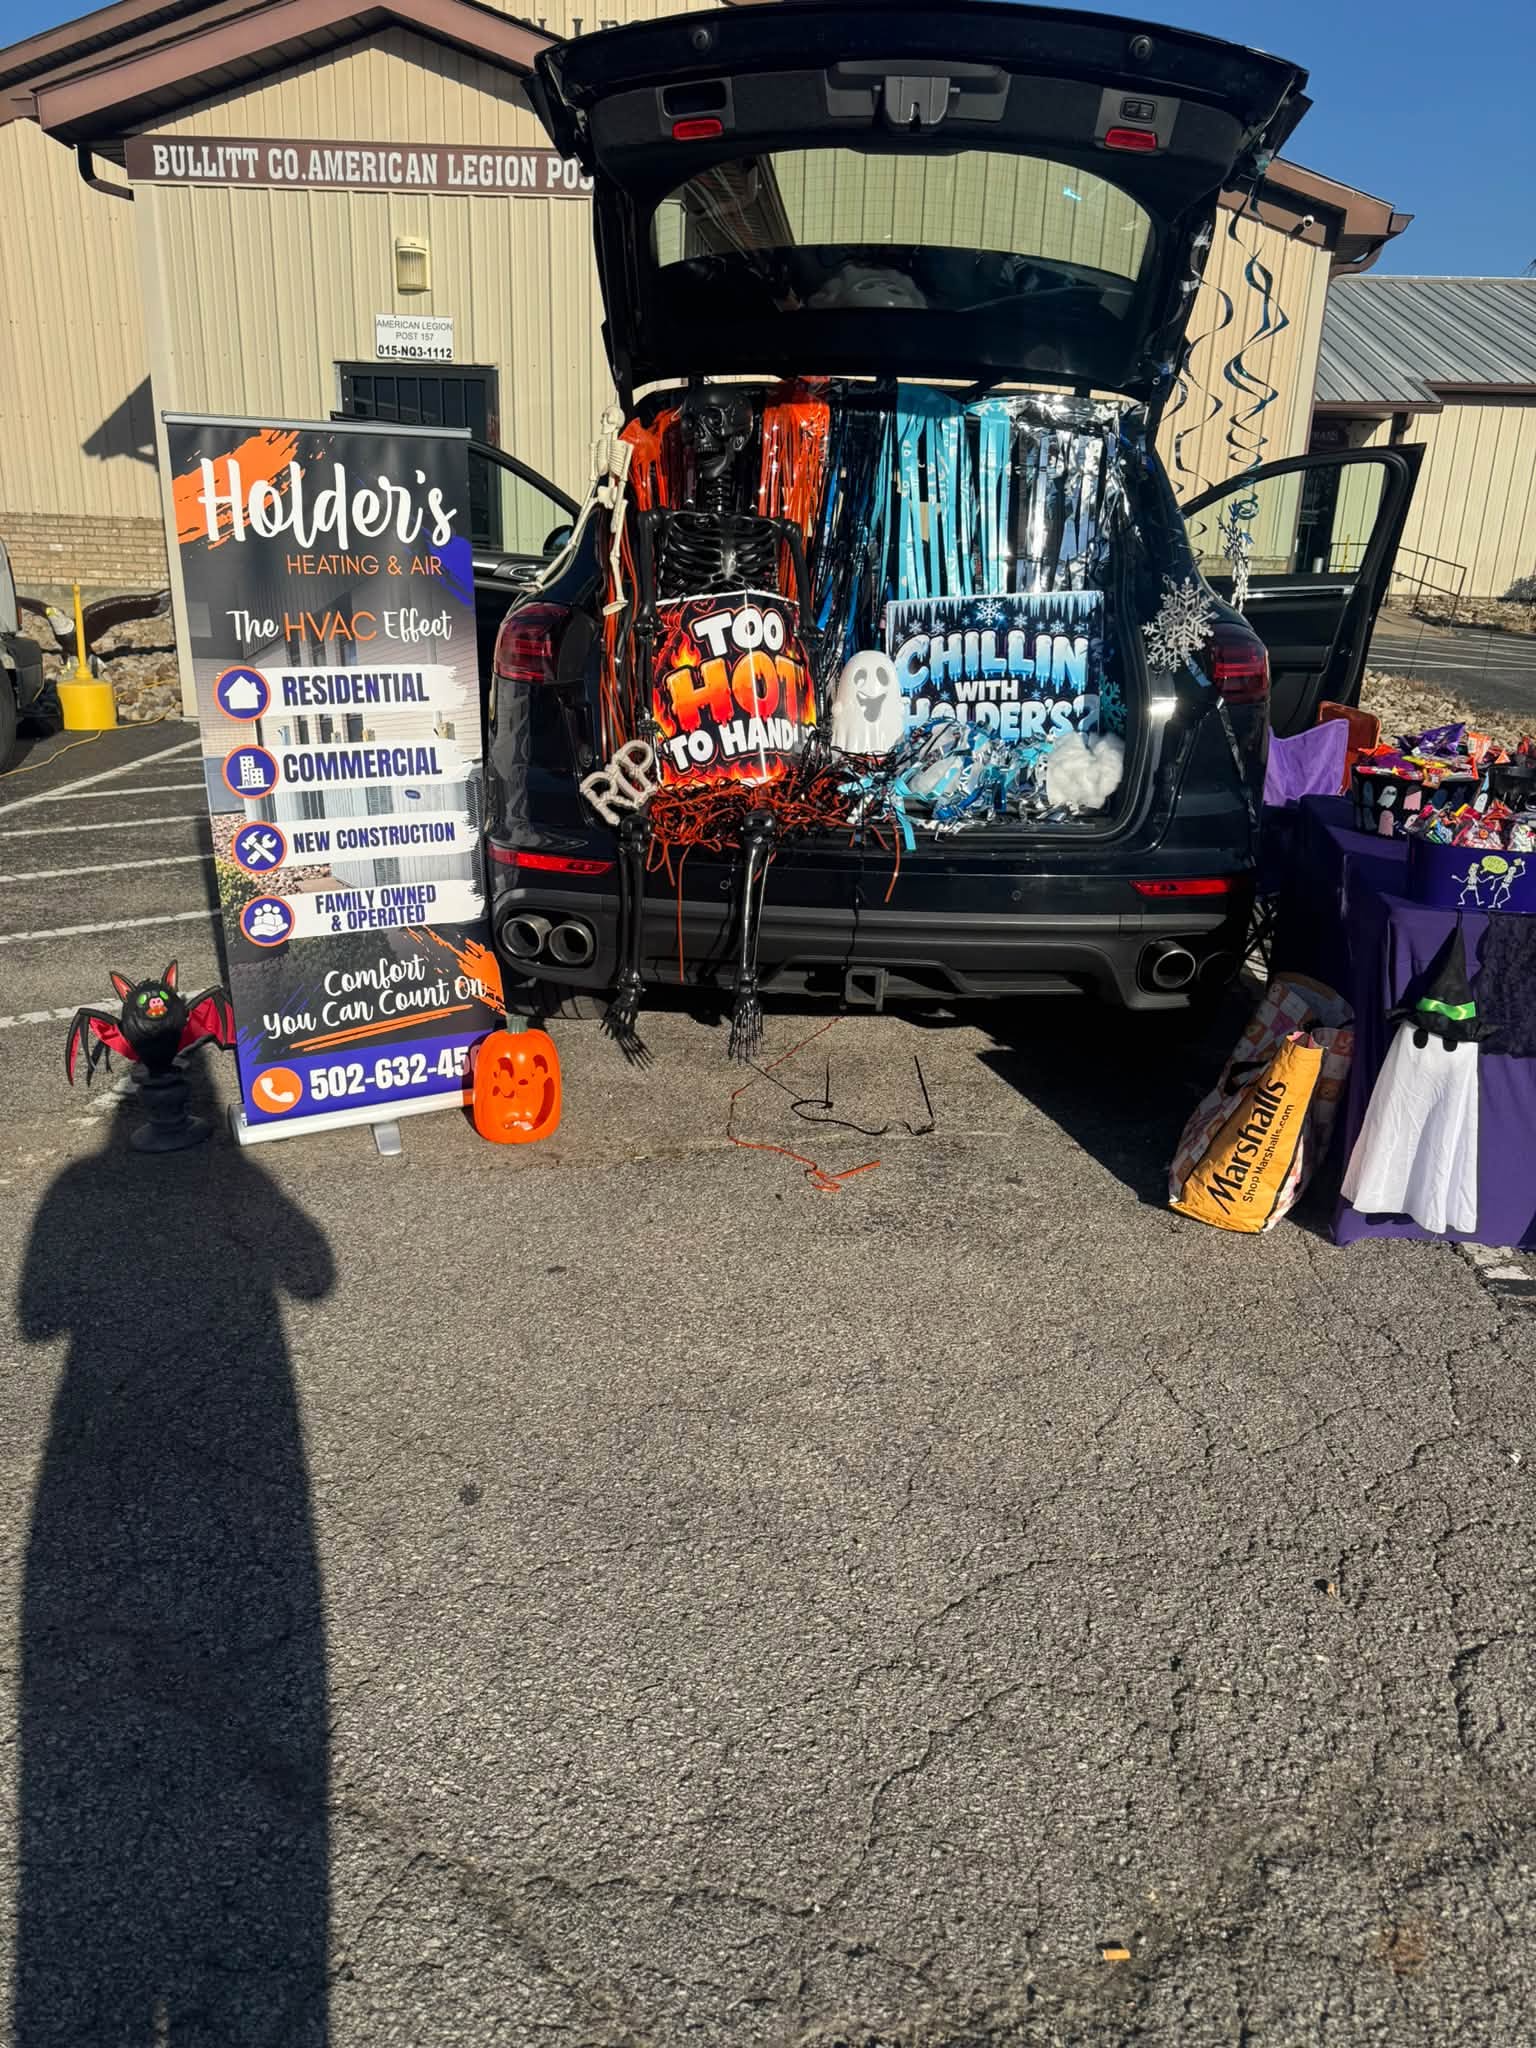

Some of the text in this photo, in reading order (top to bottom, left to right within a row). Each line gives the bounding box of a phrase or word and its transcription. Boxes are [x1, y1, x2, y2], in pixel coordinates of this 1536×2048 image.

[152, 144, 260, 178] BULLITT
[447, 154, 537, 188] LEGION
[376, 320, 453, 331] AMERICAN LEGION
[395, 331, 434, 341] POST 157
[198, 457, 457, 551] Holder's
[287, 555, 442, 576] HEATING & AIR
[226, 608, 452, 643] The HVAC Effect
[695, 609, 784, 657] TOO
[895, 630, 1089, 698] CHILLIN
[282, 673, 429, 706] RESIDENTIAL
[668, 651, 804, 733] HOT
[955, 680, 1019, 702] WITH
[283, 747, 442, 783] COMMERCIAL
[669, 731, 713, 770] TO
[579, 739, 658, 826] RIP
[293, 822, 455, 853] NEW CONSTRUCTION
[315, 885, 437, 914] FAMILY OWNED
[331, 904, 426, 932] & OPERATED
[324, 954, 425, 996] Comfort
[263, 974, 487, 1040] You Can Count On
[1206, 1078, 1287, 1215] Marshalls
[1242, 1104, 1295, 1203] Shop Marshalls.com
